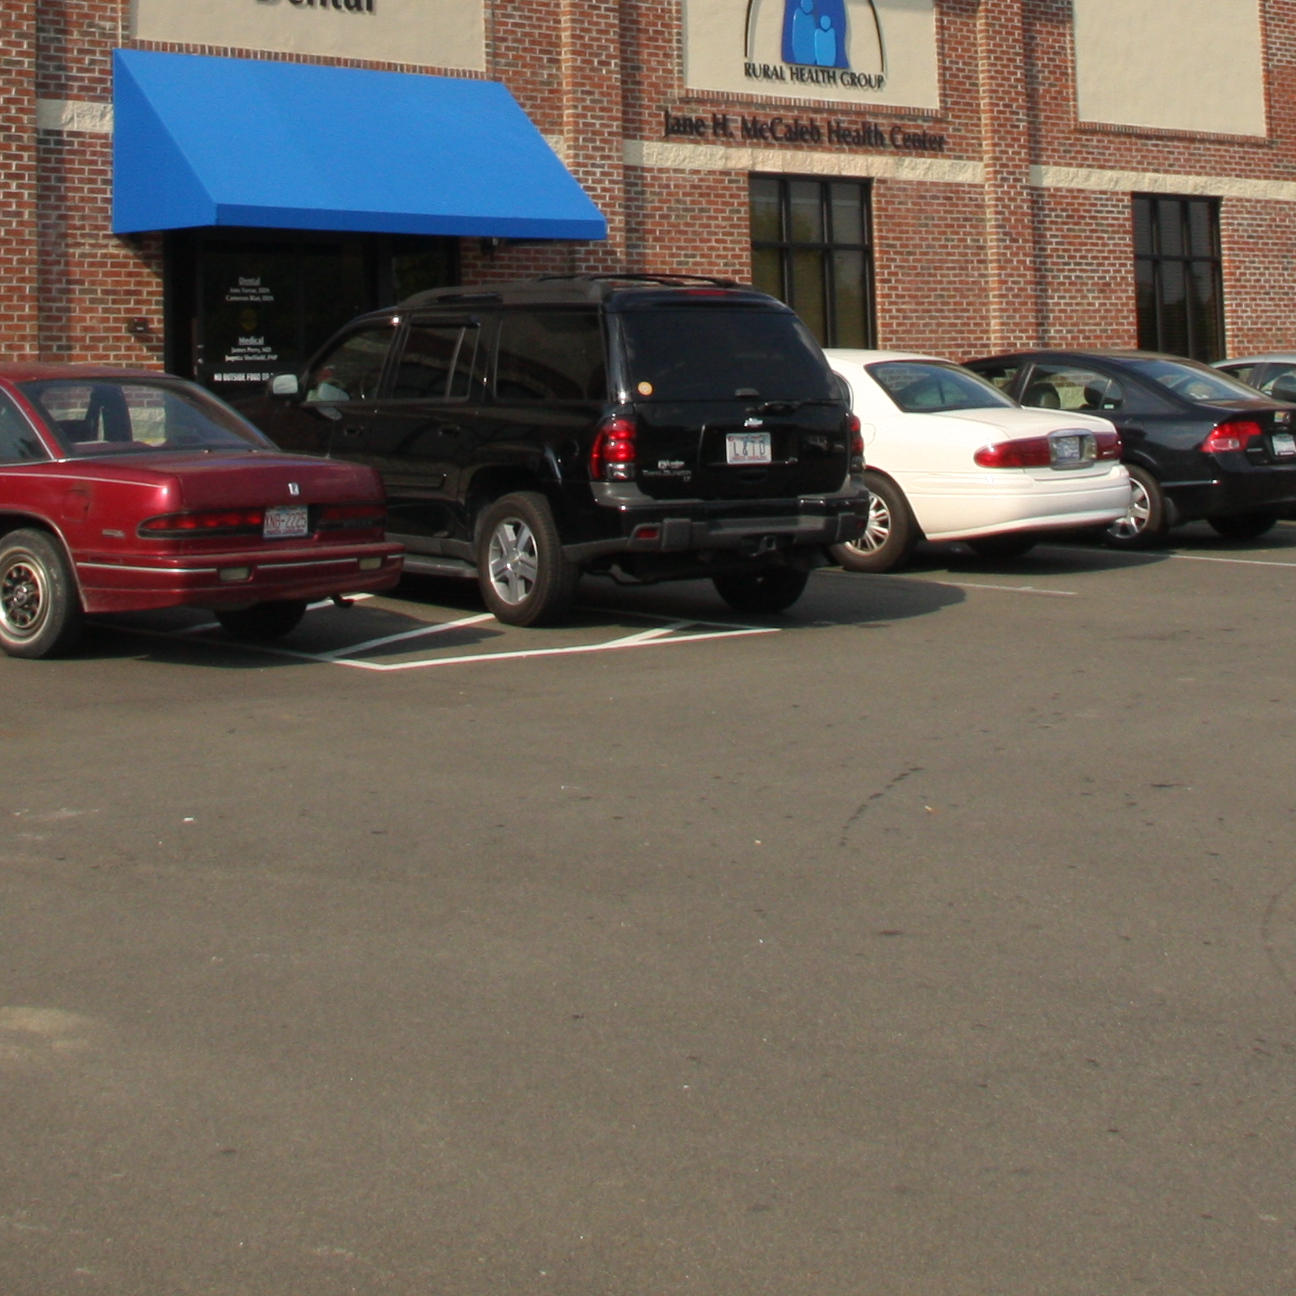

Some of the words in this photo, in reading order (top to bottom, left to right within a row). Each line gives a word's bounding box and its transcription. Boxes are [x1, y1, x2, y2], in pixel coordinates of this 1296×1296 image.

[744, 62, 786, 81] RURAL
[790, 66, 838, 85] HEALTH
[839, 71, 885, 90] GROUP
[664, 109, 706, 138] Jane
[712, 112, 734, 139] H.
[740, 115, 823, 144] McCaleb
[827, 120, 886, 149] Health
[890, 125, 946, 151] Center
[238, 336, 264, 345] Medical
